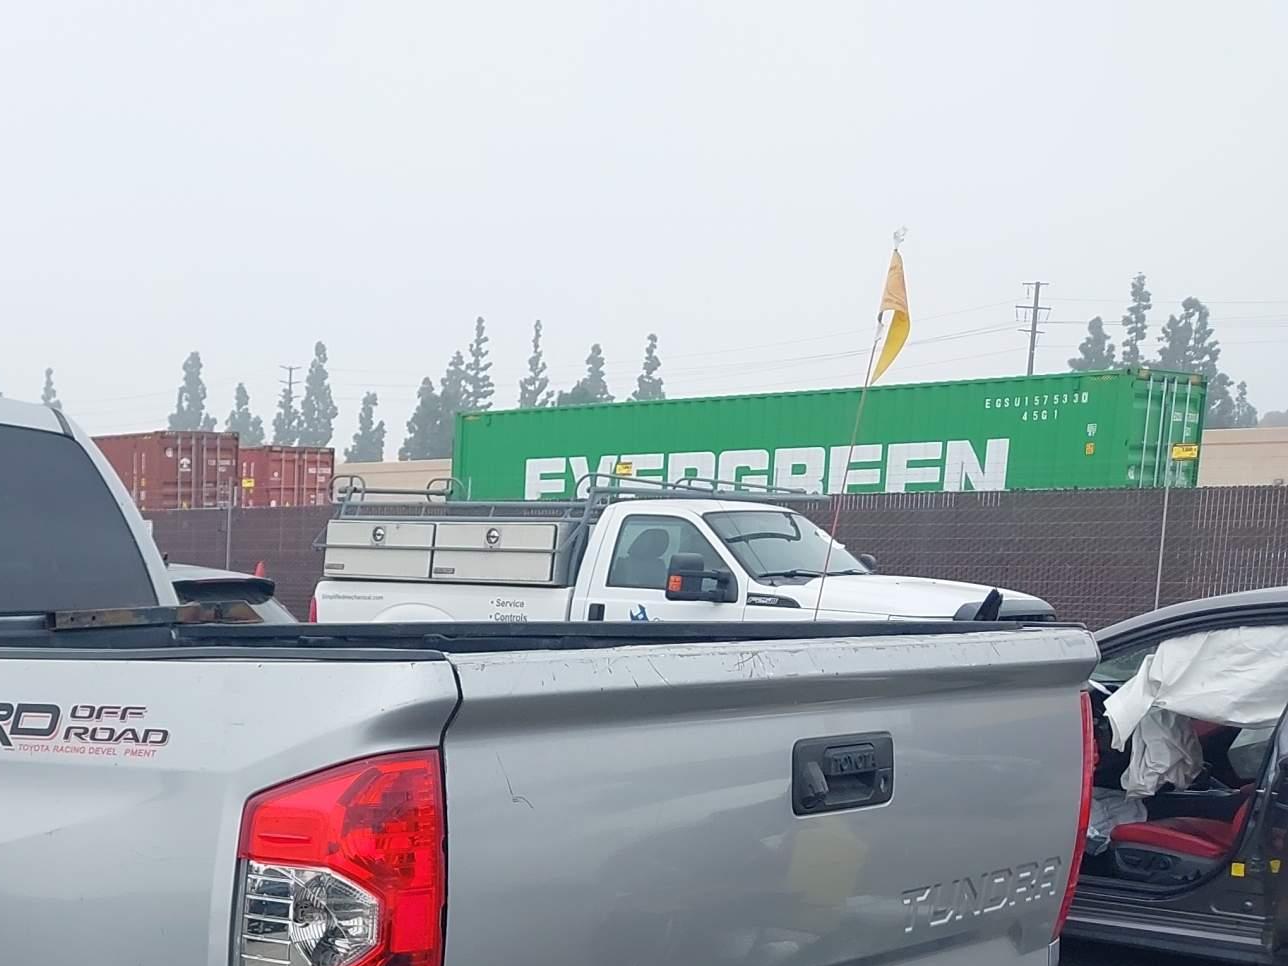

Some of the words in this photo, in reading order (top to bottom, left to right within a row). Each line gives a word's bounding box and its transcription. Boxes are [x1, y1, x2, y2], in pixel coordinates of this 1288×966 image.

[495, 599, 525, 609] Service
[493, 612, 528, 623] Controls
[69, 703, 147, 722] OFF
[62, 725, 170, 746] ROAD
[18, 743, 50, 753] TOYOTA
[52, 744, 86, 755] RACING
[831, 751, 877, 774] TOYOTA
[901, 855, 1062, 933] TUNDRA
